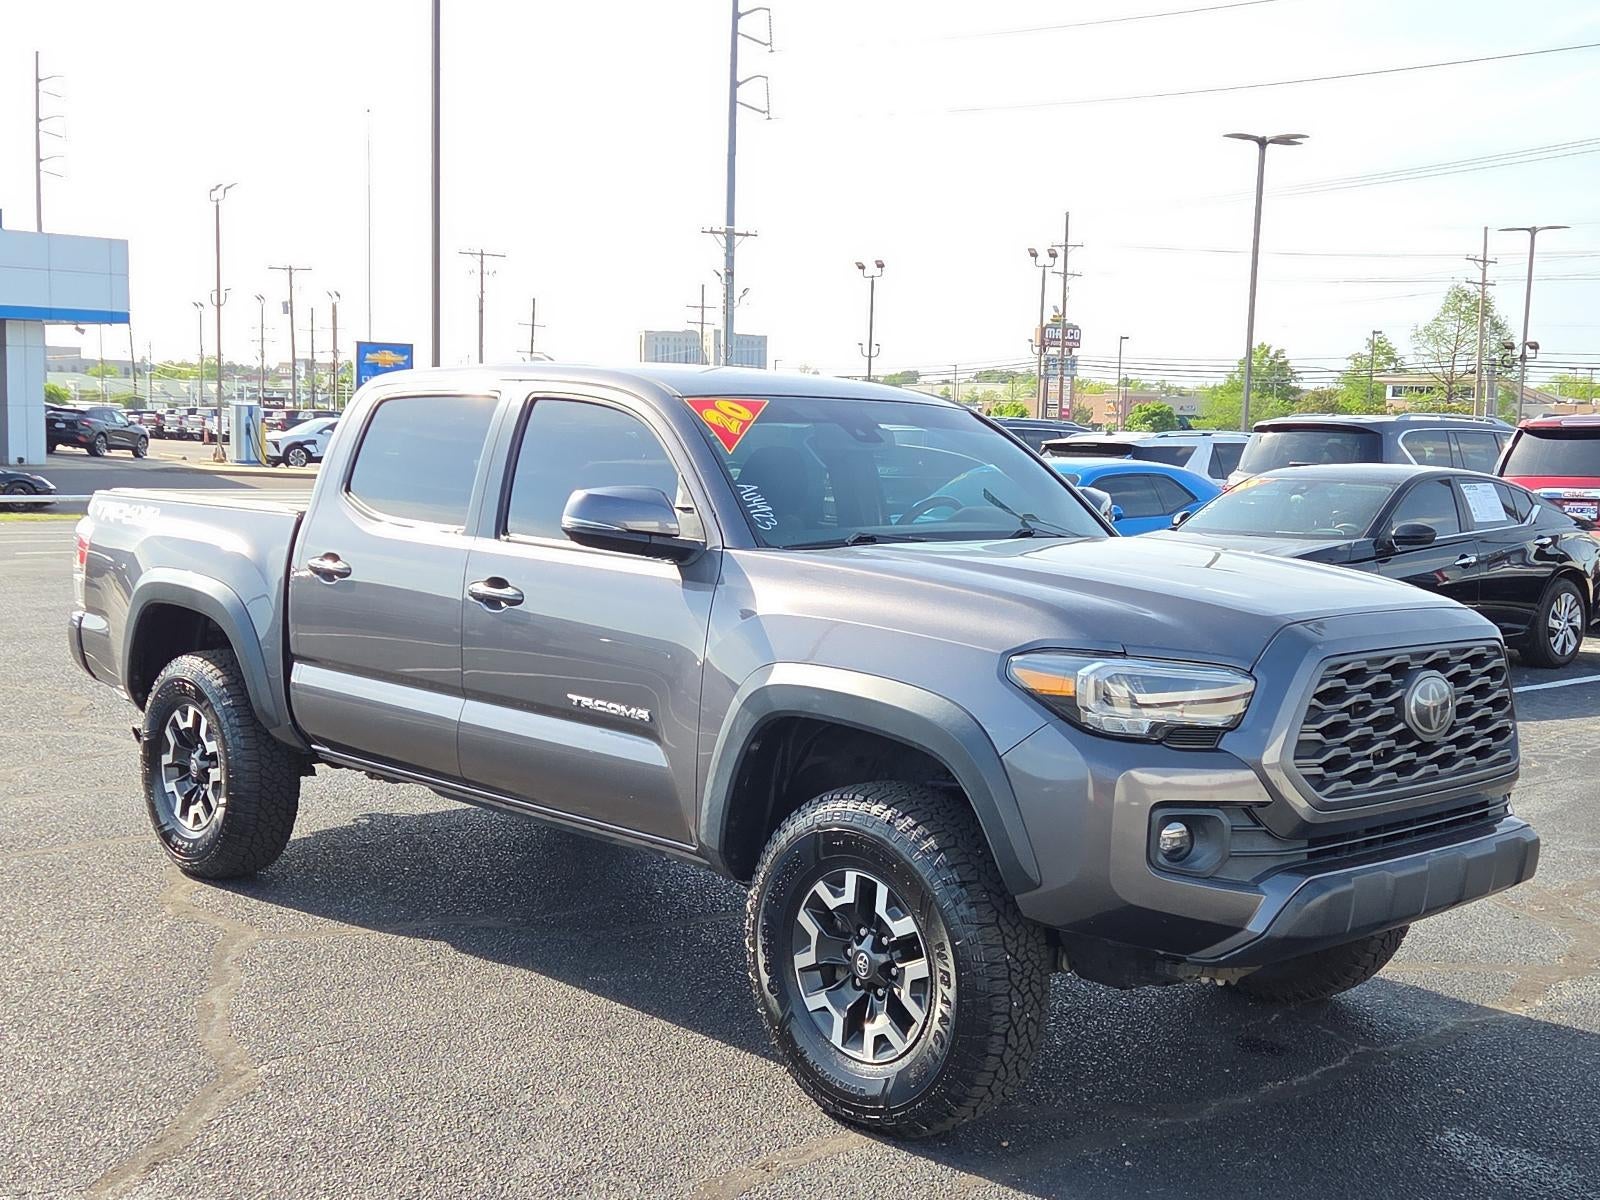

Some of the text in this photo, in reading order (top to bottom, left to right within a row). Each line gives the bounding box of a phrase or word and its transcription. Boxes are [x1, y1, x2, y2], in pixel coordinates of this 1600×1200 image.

[1045, 328, 1080, 340] MACO
[702, 399, 754, 435] 20
[566, 693, 651, 722] TACOMA
